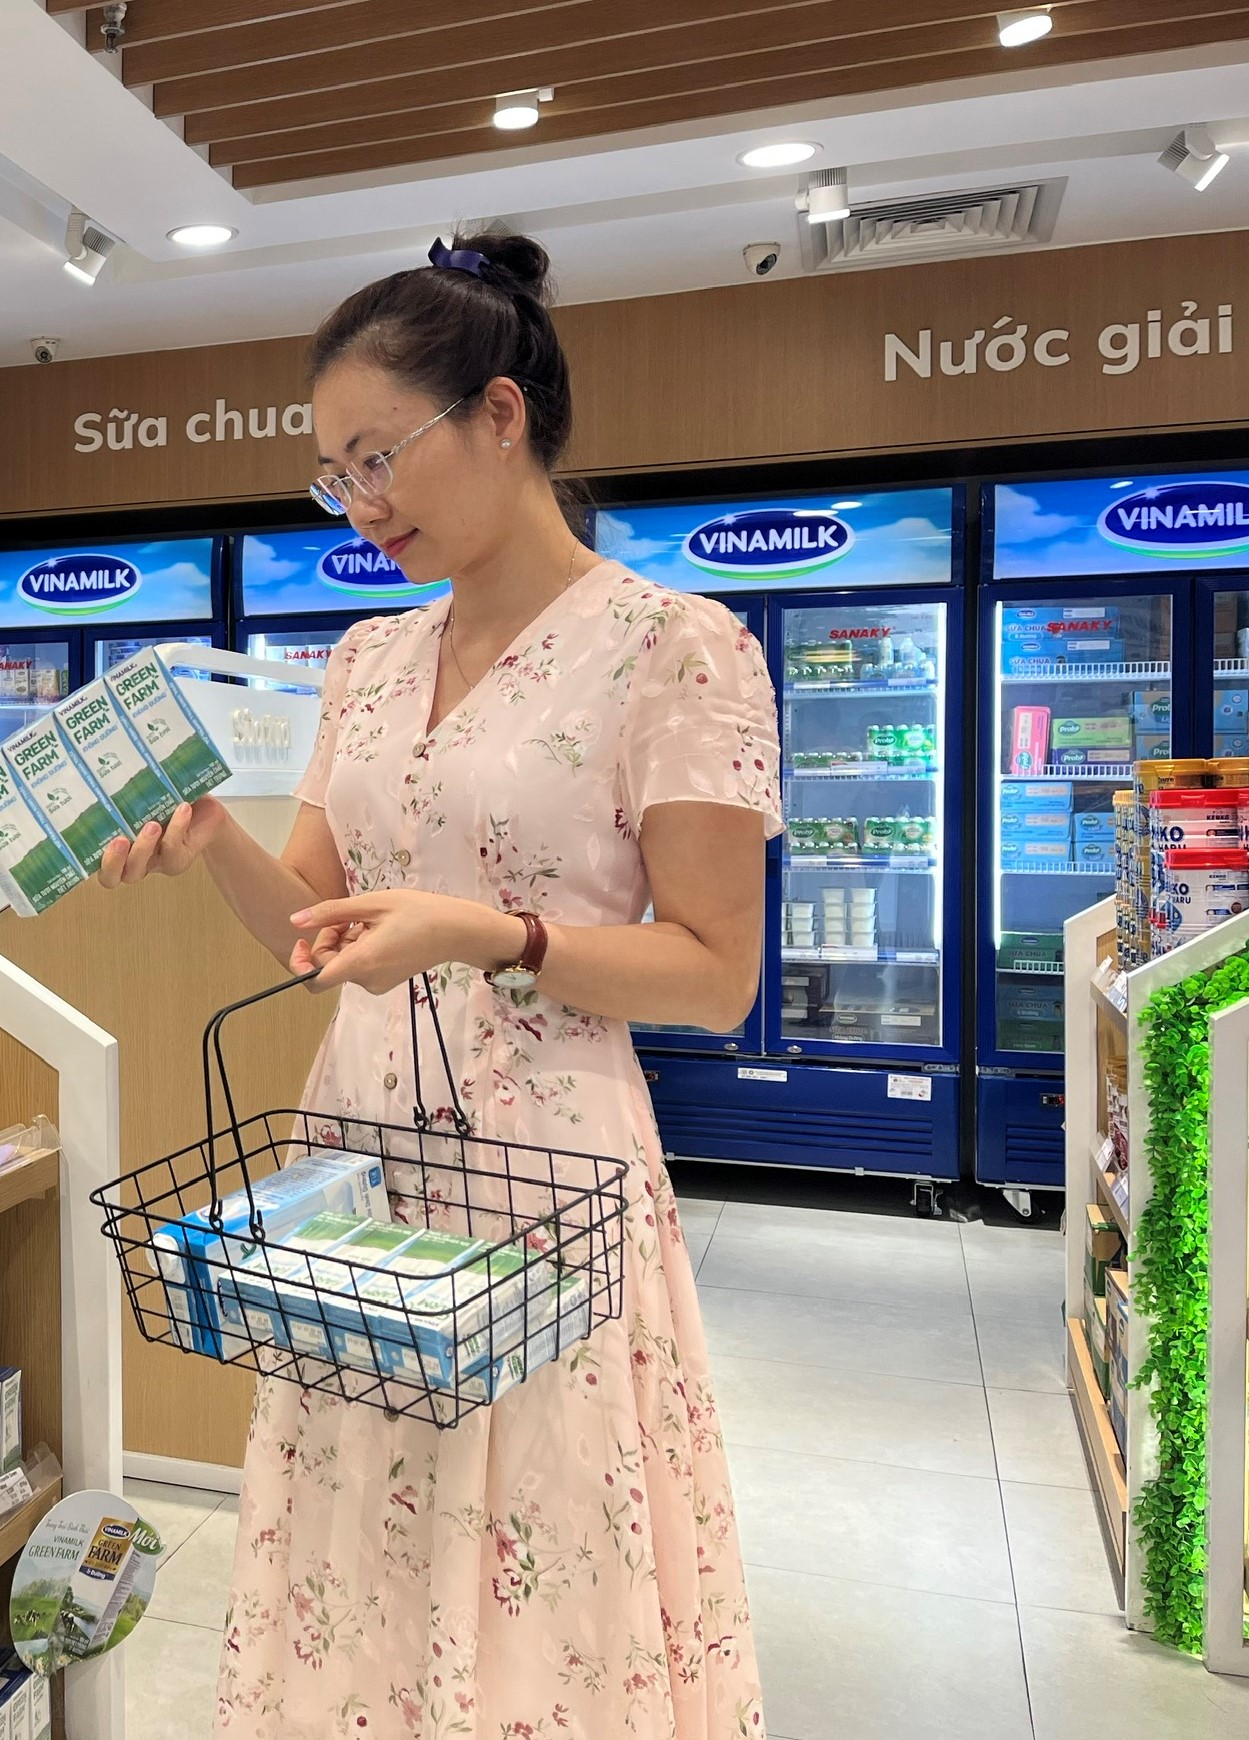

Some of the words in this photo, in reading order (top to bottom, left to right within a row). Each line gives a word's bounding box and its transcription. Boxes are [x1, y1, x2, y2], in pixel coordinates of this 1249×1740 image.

[885, 316, 1069, 381] Nước
[1099, 301, 1233, 374] giải
[74, 407, 167, 452] Sữa
[186, 399, 313, 443] chua
[699, 525, 839, 555] VINAMILK
[30, 569, 130, 593] VINAMILK
[829, 628, 891, 639] SANAKY
[1046, 621, 1113, 633] SANAKY
[116, 662, 159, 696] GREEN
[59, 696, 88, 716] VINAMILK
[123, 680, 160, 710] FARM
[66, 695, 109, 730] GREEN
[7, 731, 38, 753] VINAMILK
[73, 713, 110, 745] FARM
[14, 730, 58, 767] GREEN
[22, 749, 60, 782] FARM
[54, 1536, 84, 1546] VINAMILK
[98, 1540, 122, 1550] GREEN
[128, 1528, 159, 1550] Mới
[88, 1546, 121, 1565] FARM
